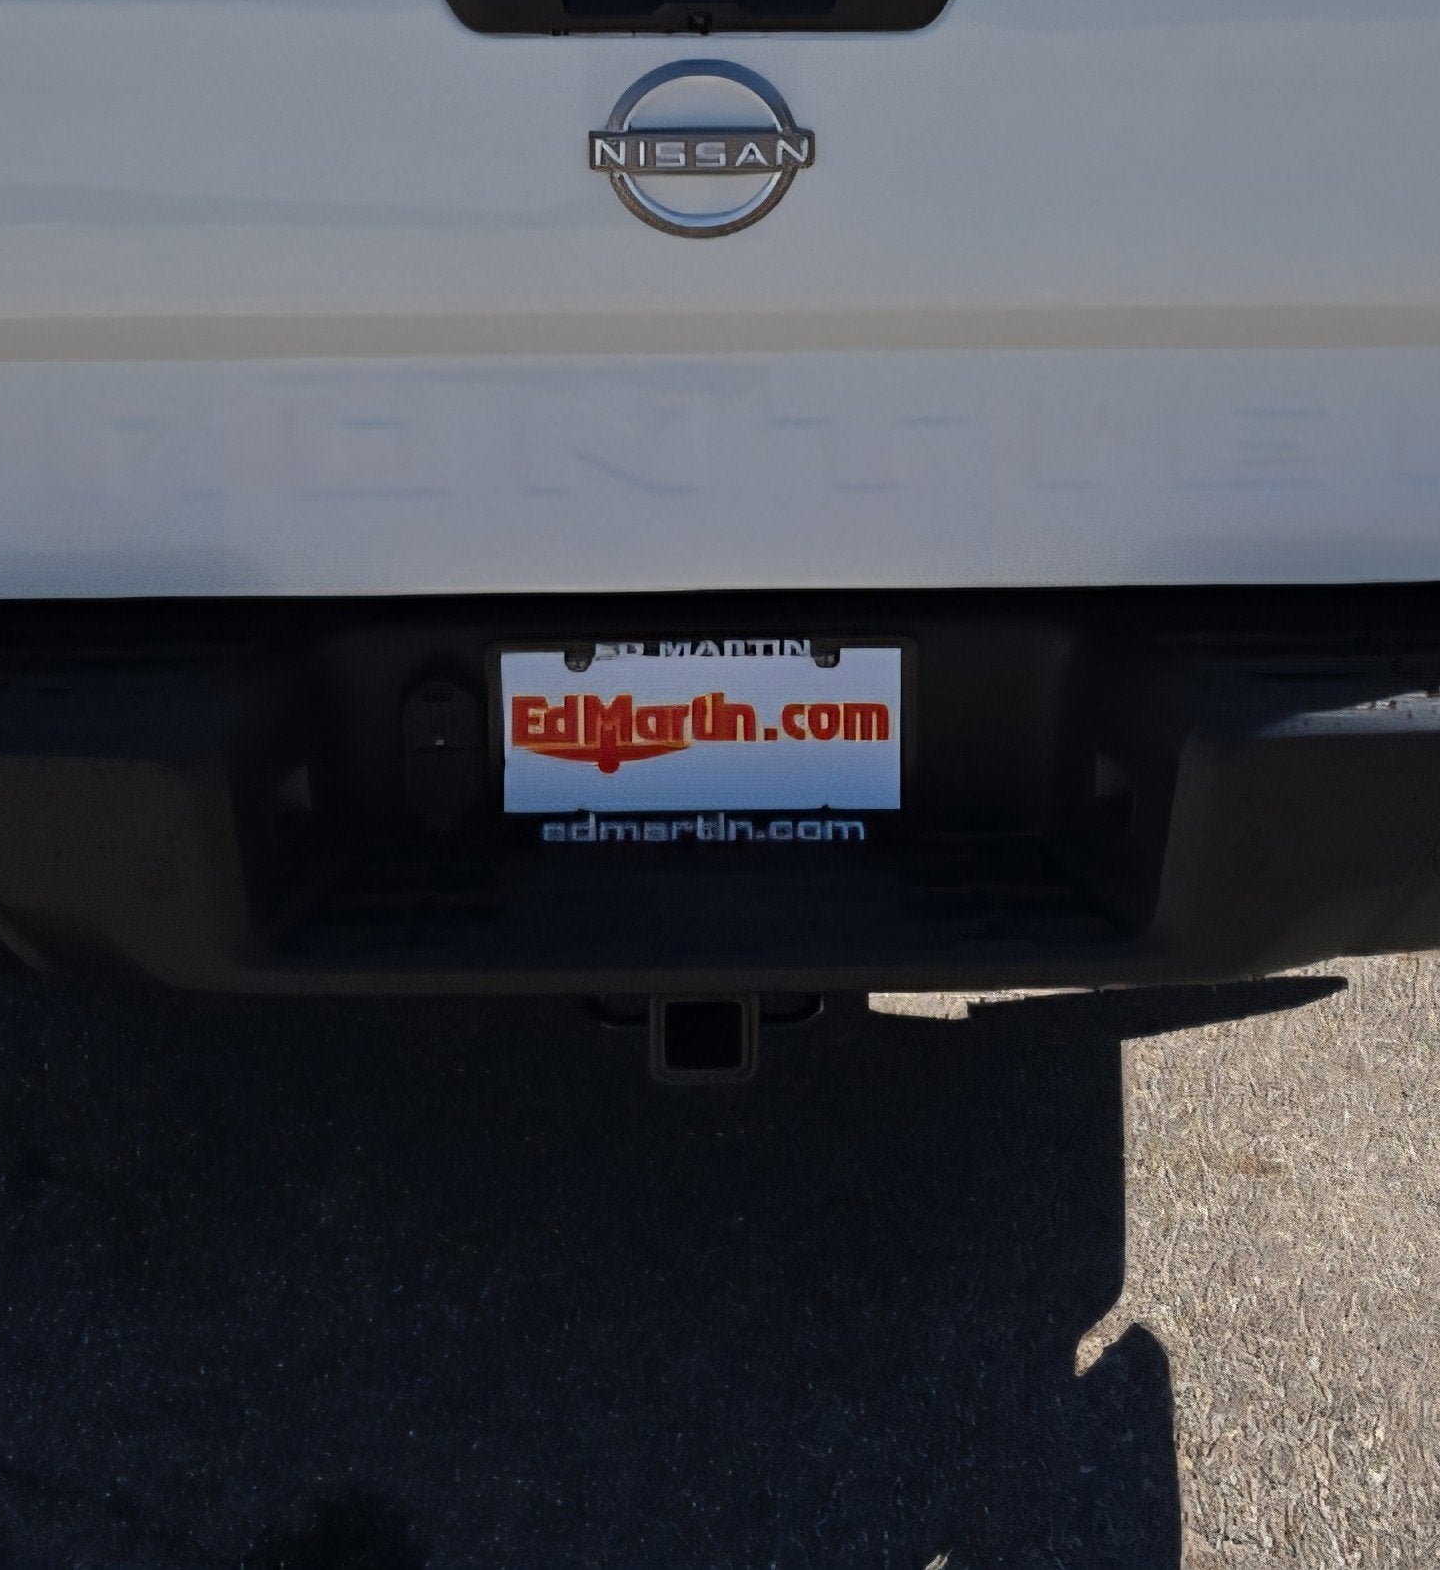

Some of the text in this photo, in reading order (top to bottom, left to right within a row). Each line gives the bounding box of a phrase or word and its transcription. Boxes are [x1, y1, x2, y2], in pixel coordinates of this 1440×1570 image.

[594, 137, 810, 168] NISSAN
[511, 692, 890, 749] EdMartin.com
[542, 812, 866, 843] edmartin.com
